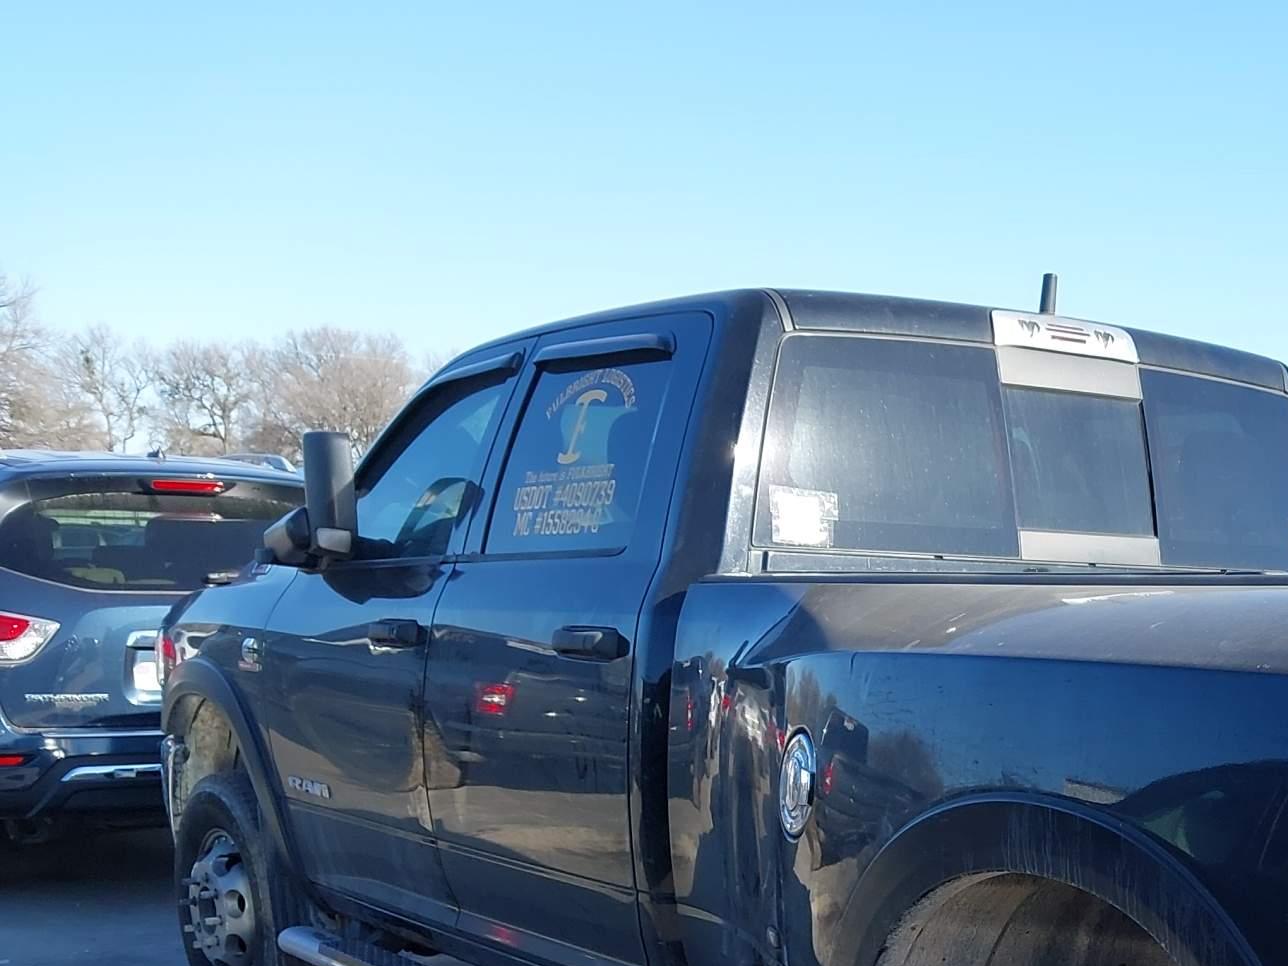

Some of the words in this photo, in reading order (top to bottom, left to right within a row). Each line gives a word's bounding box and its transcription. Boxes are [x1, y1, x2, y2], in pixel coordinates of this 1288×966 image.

[513, 485, 553, 512] USDOT
[513, 512, 533, 537] MC
[287, 775, 332, 800] RAM
